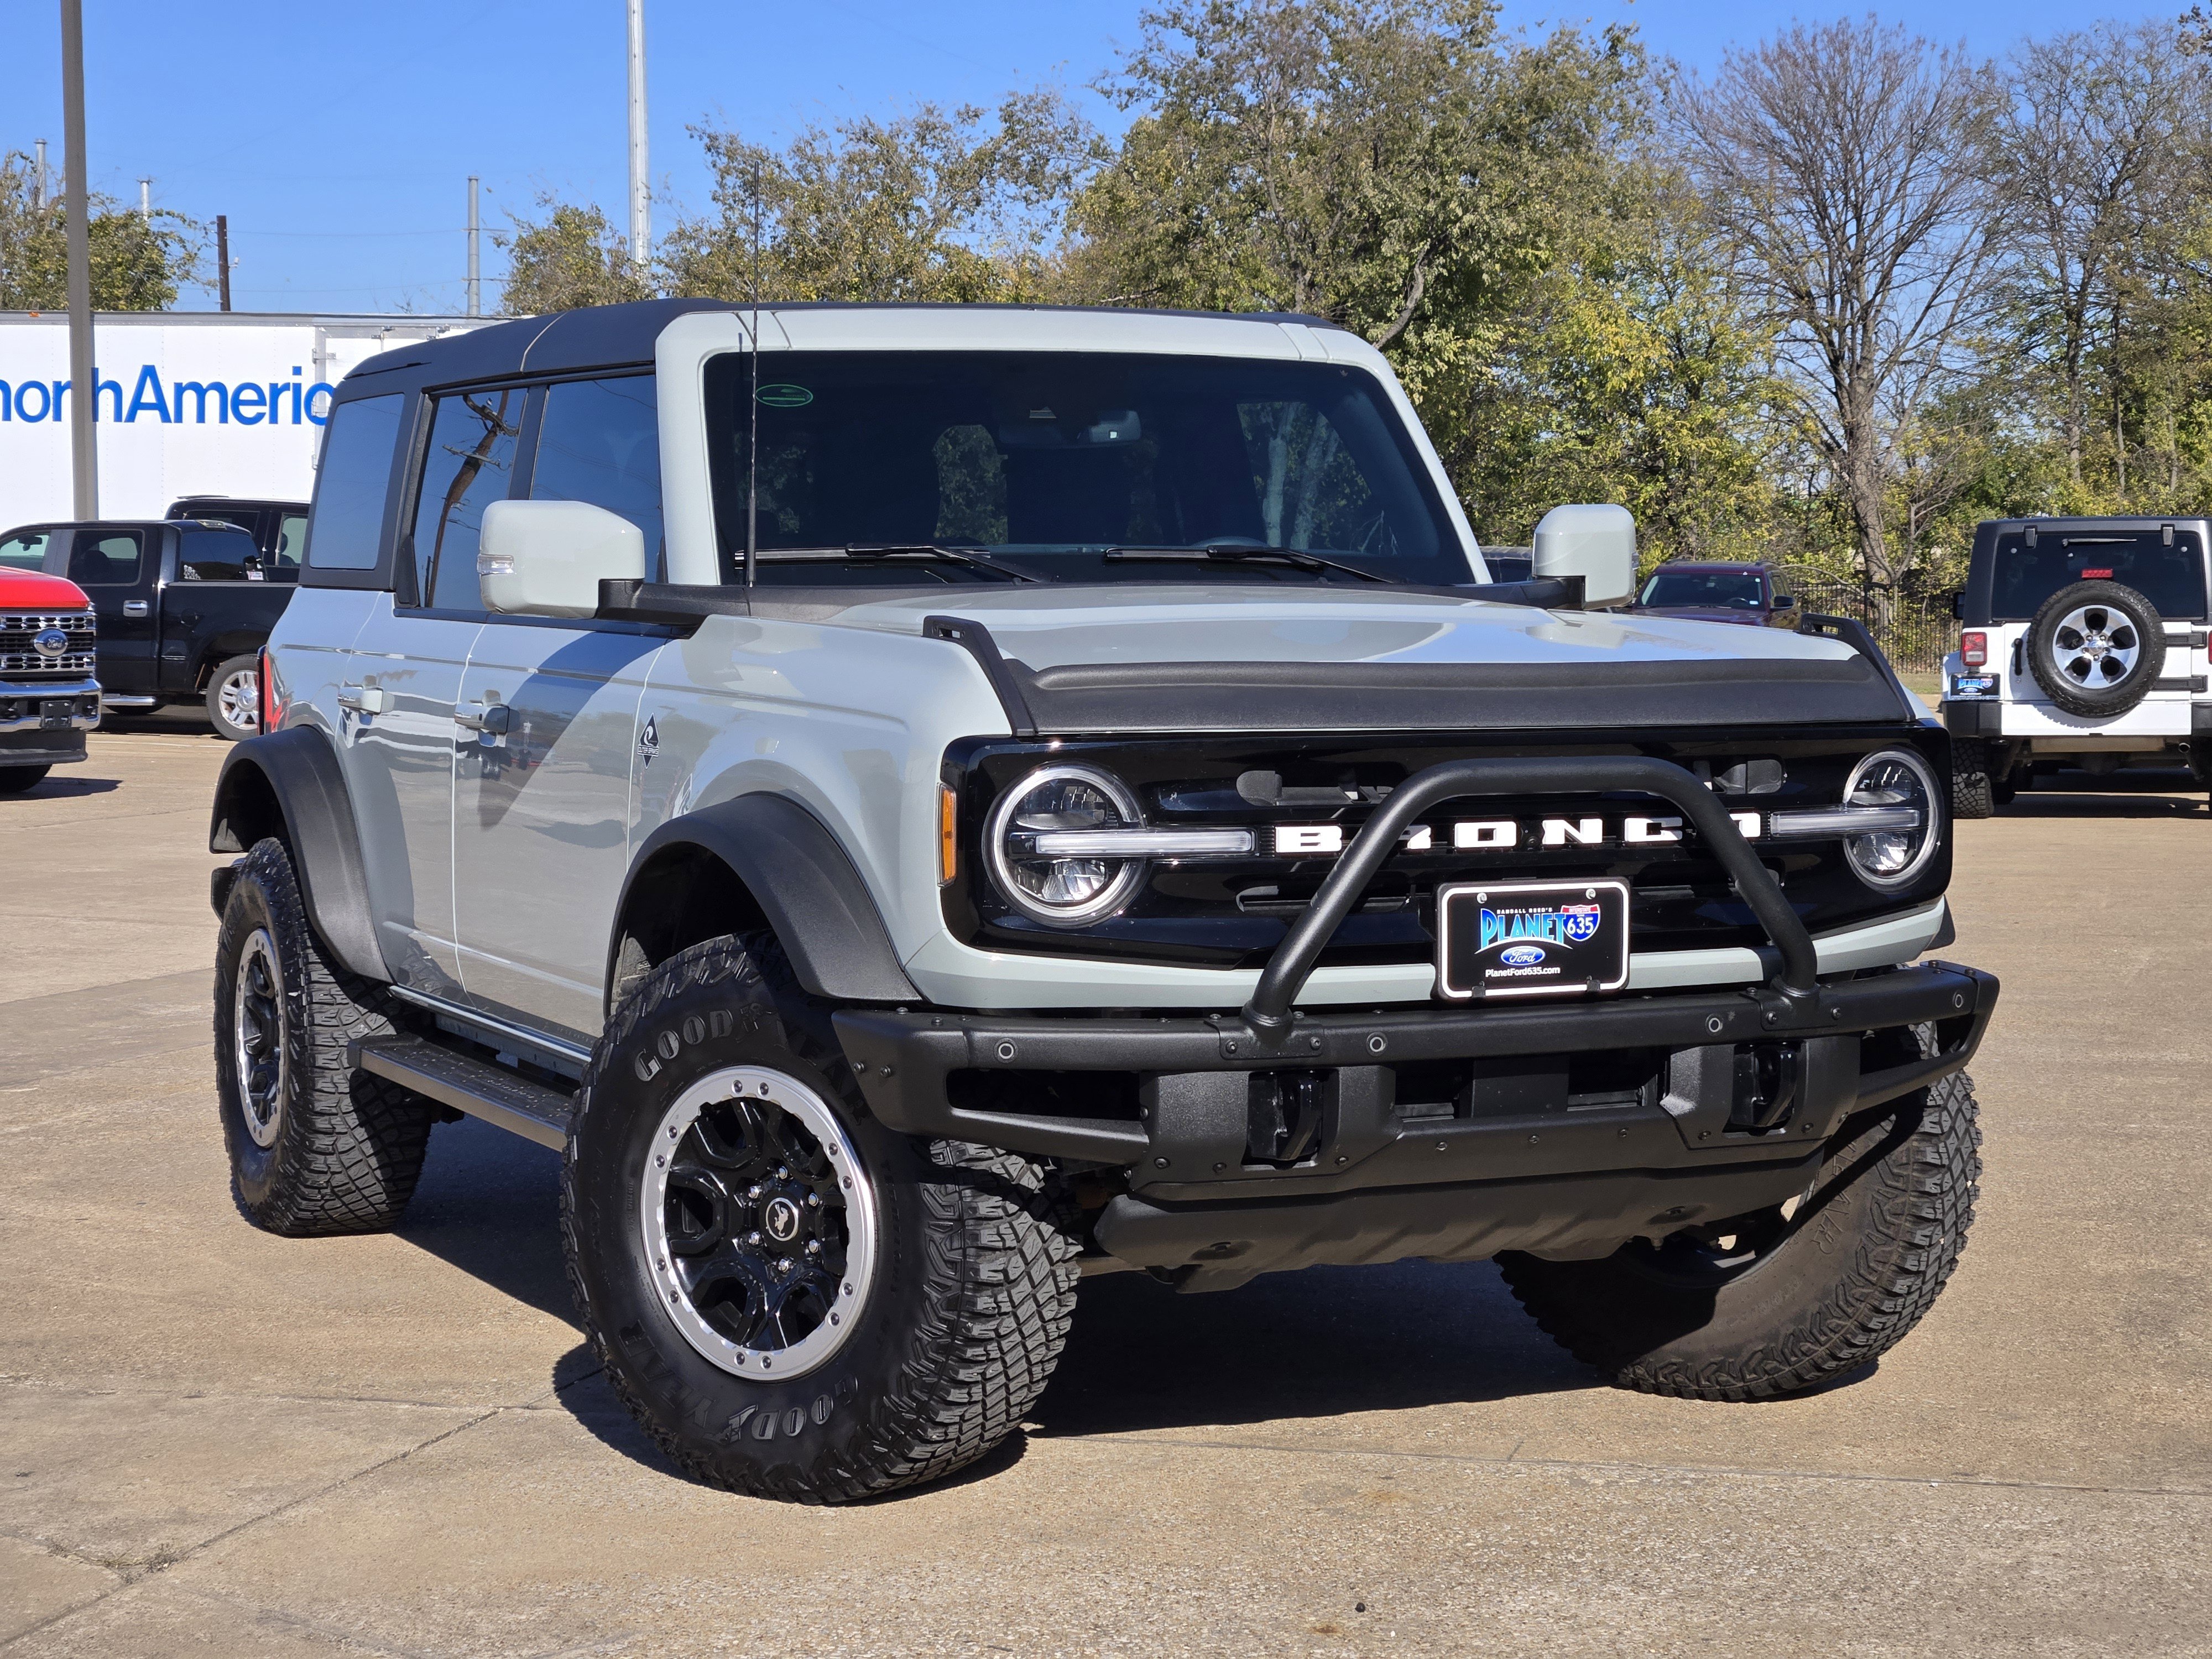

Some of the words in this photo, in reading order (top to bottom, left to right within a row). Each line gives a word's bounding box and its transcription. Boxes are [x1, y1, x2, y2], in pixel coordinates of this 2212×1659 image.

[1480, 908, 1566, 950] PLANET
[1567, 916, 1594, 934] 635
[1509, 948, 1536, 963] Ford
[1485, 967, 1561, 977] PlanetFord635.com
